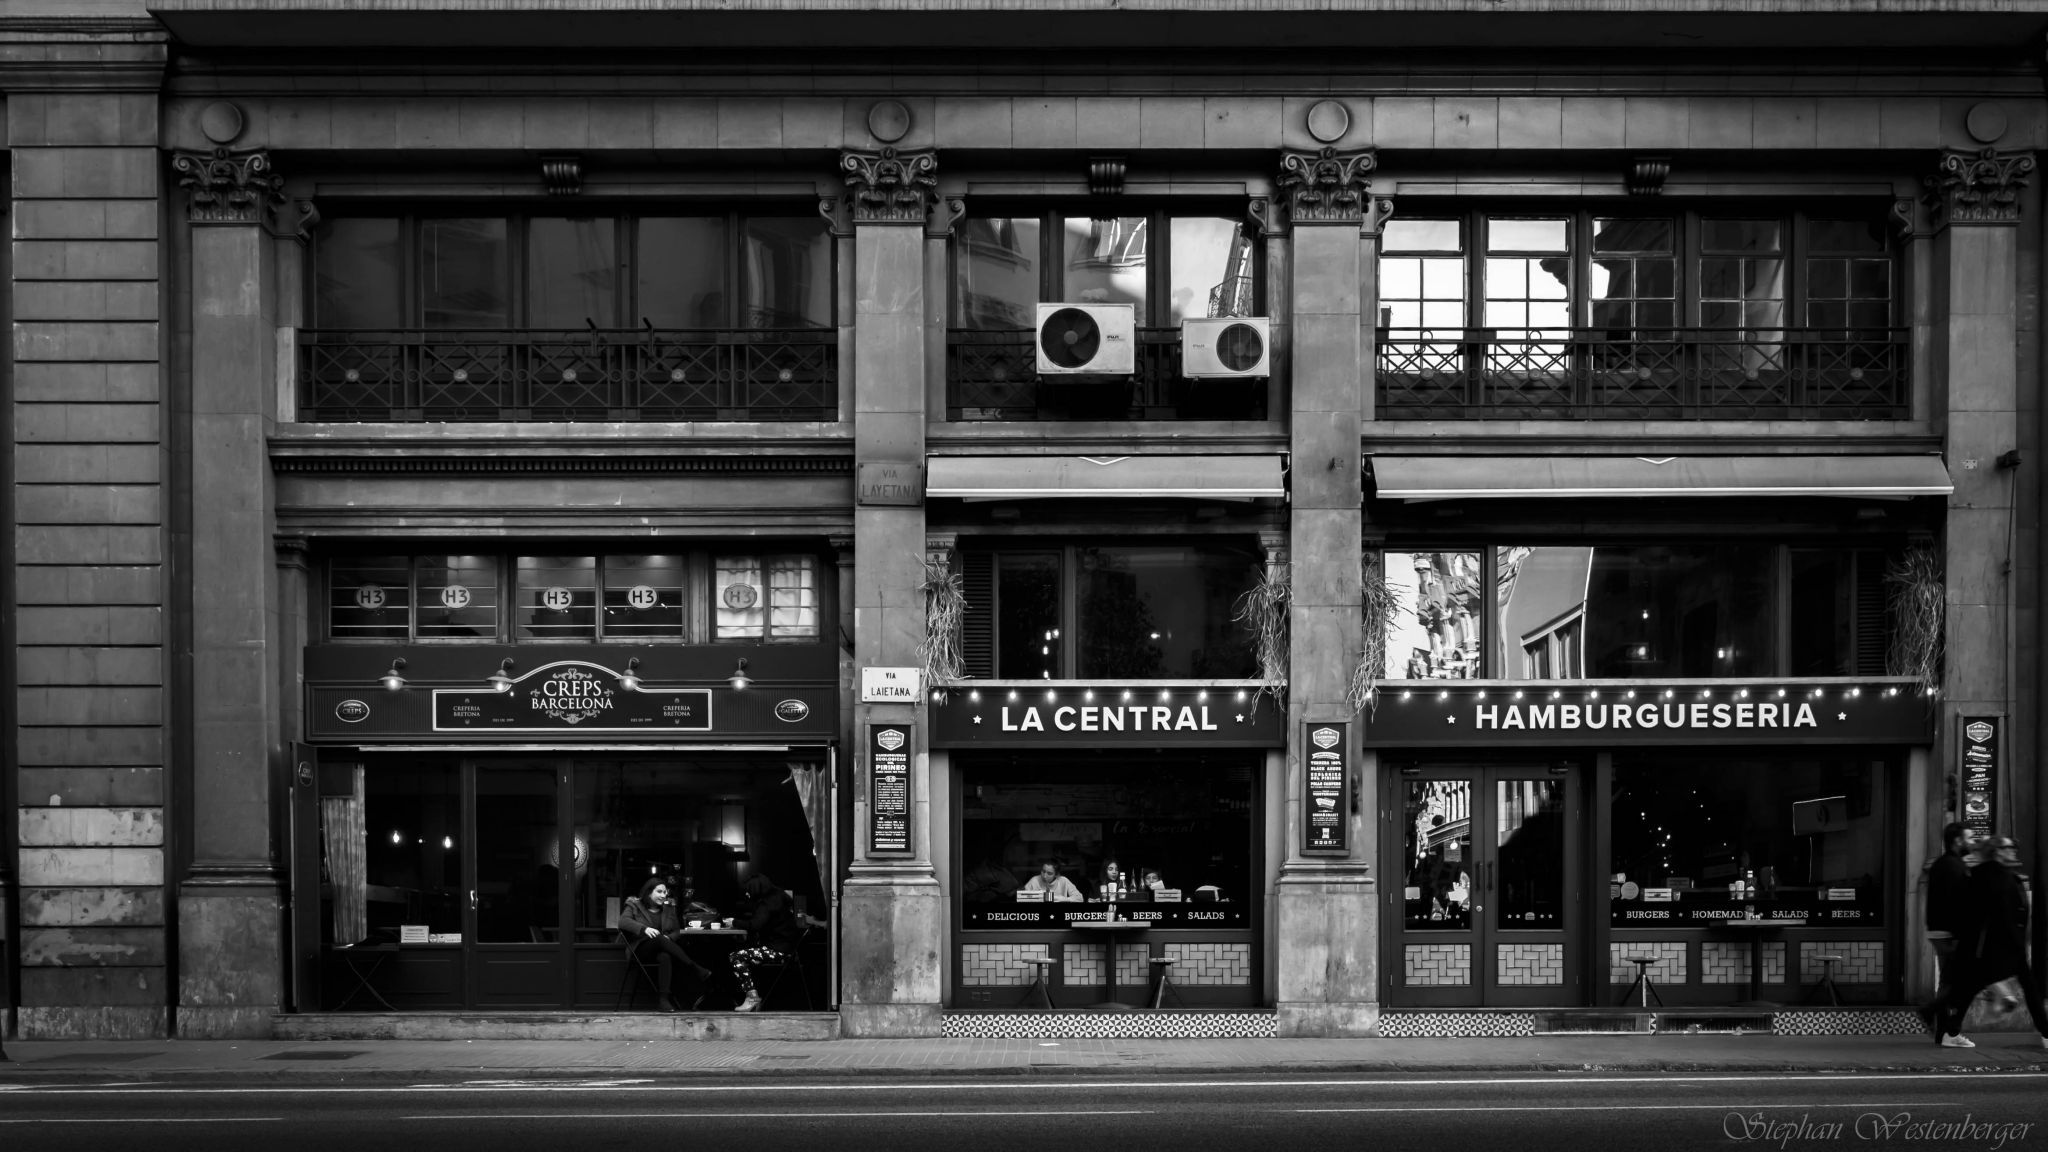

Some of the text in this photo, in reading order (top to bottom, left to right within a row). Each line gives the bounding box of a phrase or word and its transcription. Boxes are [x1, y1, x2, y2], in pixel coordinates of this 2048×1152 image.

[883, 469, 897, 478] VIA
[862, 484, 917, 498] LAYETANA
[361, 590, 383, 604] H3
[445, 589, 468, 604] H3
[547, 591, 570, 605] H3
[632, 590, 654, 604] H3
[730, 590, 752, 603] H3
[543, 680, 602, 697] CREPS
[871, 687, 911, 697] LAIETANA
[532, 697, 614, 709] BARCELONA
[1001, 705, 1218, 731] LA CENTRAL
[1475, 703, 1818, 730] HAMBURGUESERIA
[987, 911, 1225, 921] DELICIOUS BURGERS BEERS SALADS
[1626, 910, 1861, 919] BURGERS HOMEMAD SALADS BEERS
